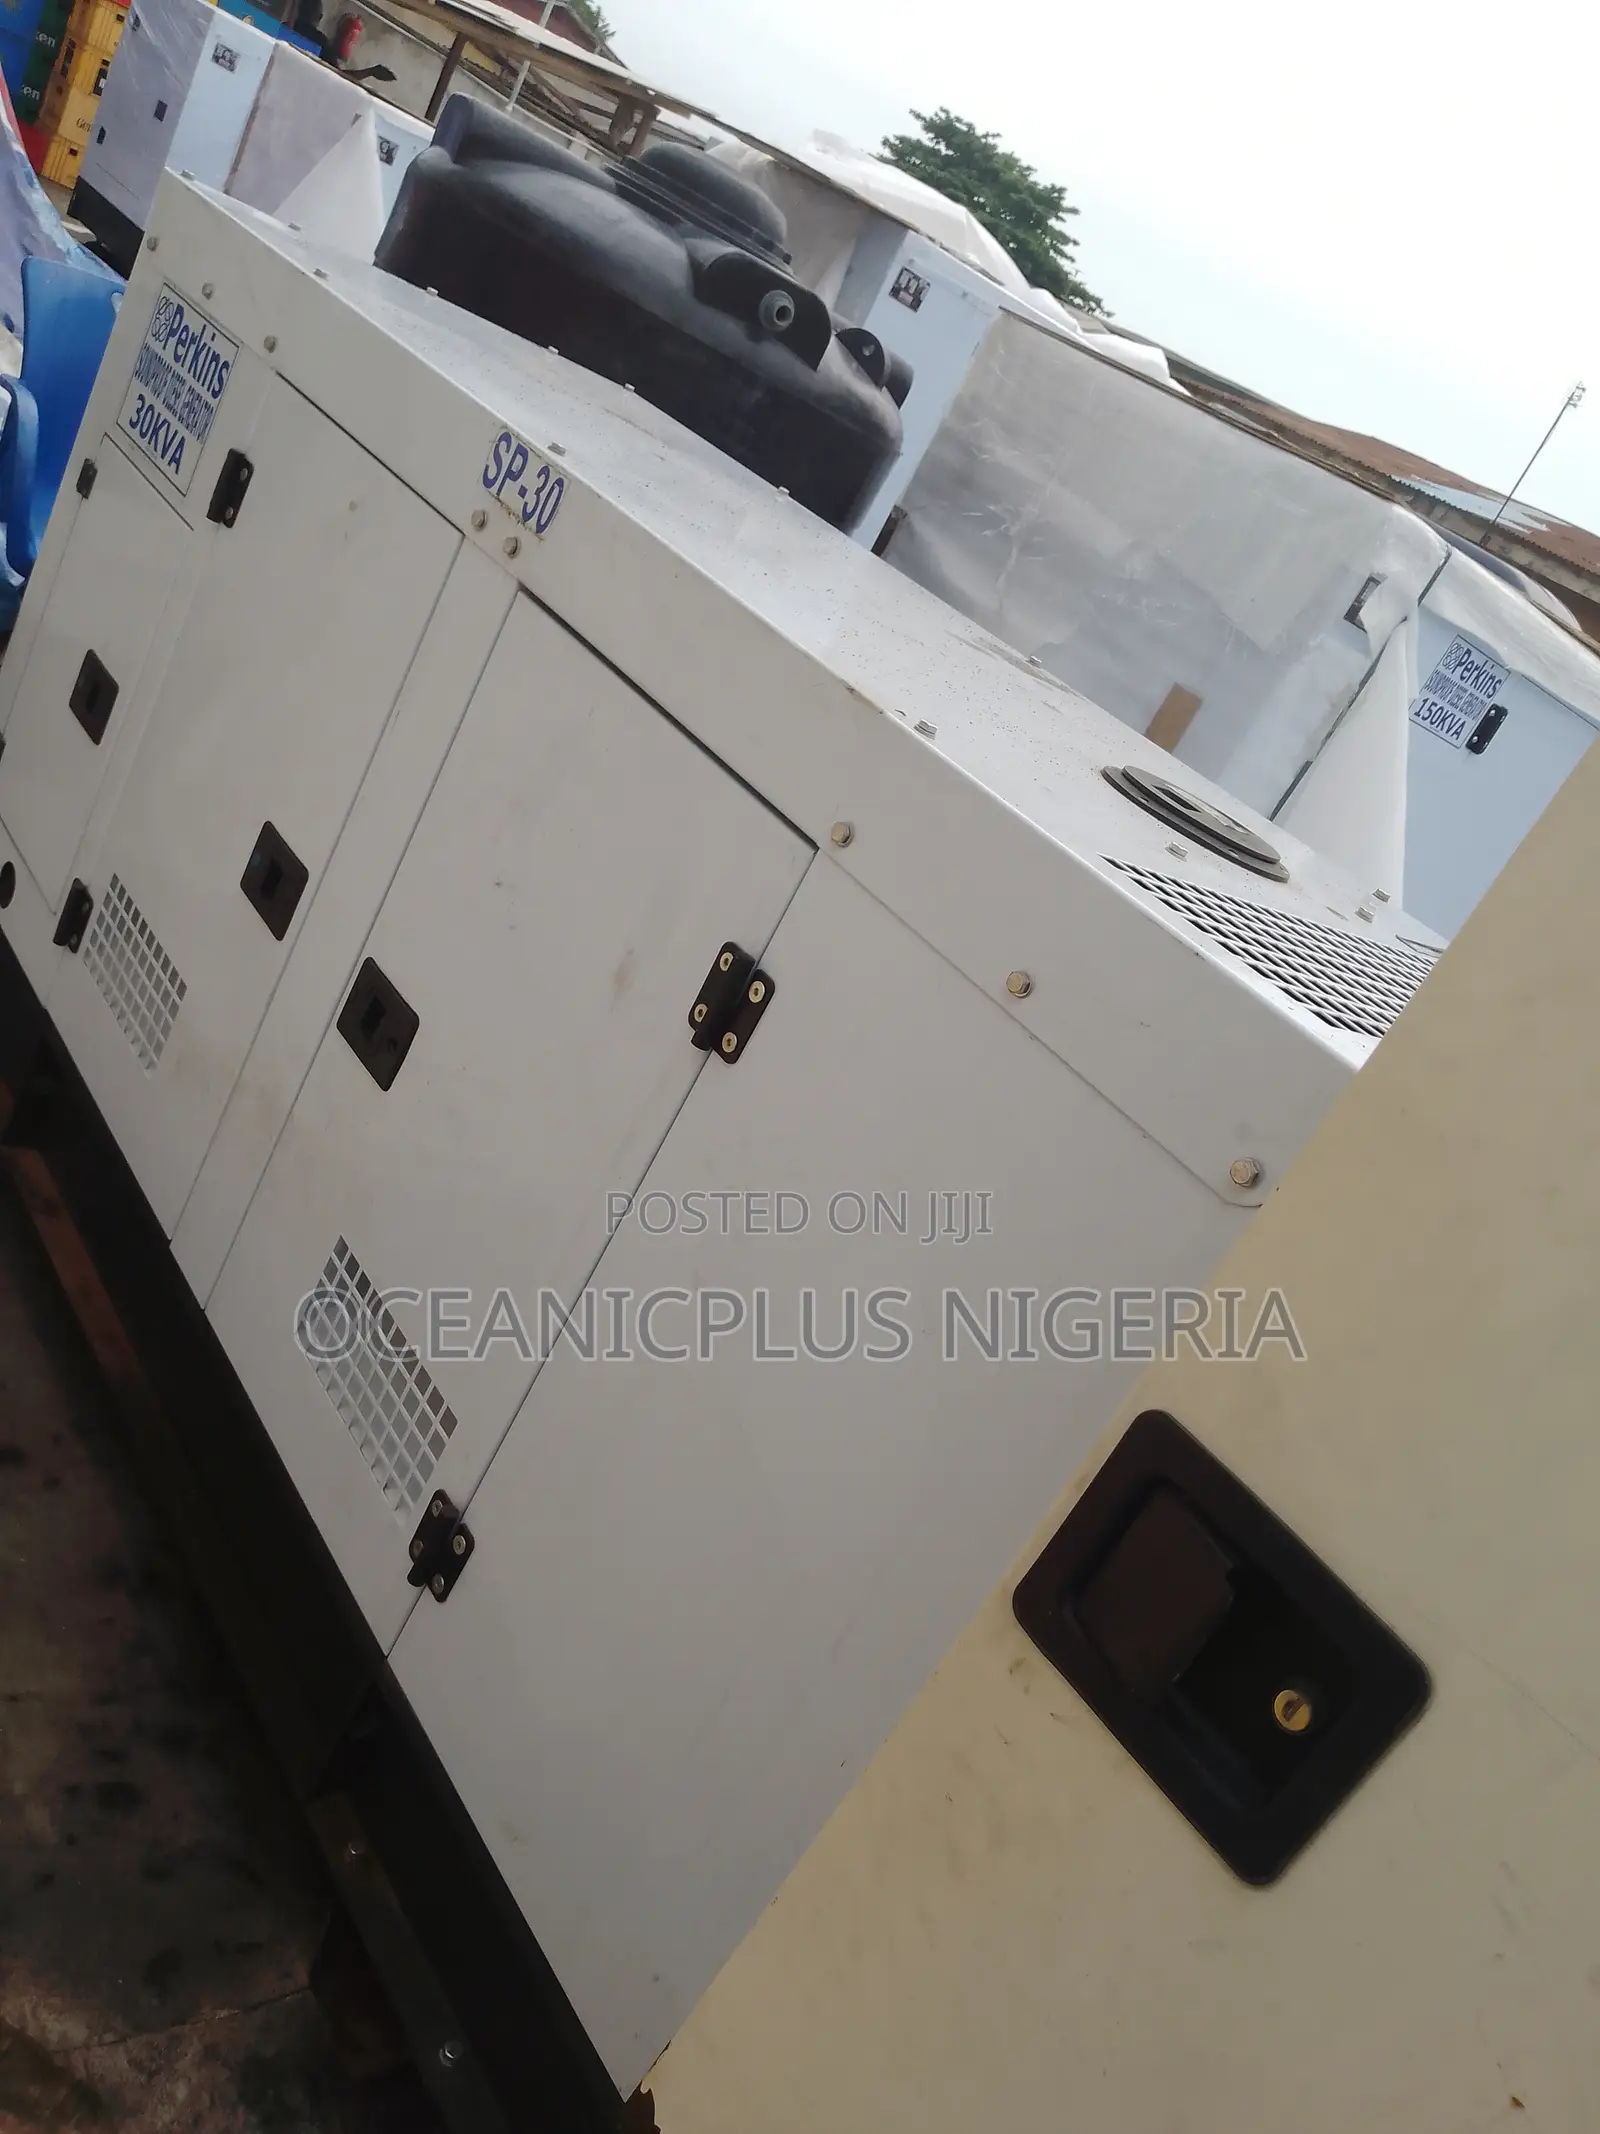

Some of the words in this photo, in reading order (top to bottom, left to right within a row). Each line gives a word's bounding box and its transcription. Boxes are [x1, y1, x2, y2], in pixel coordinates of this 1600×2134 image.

[162, 303, 230, 400] Perkins
[129, 393, 186, 475] 30KVA
[482, 431, 565, 534] SP-30
[1451, 647, 1503, 700] Perkins
[1413, 697, 1467, 741] 150KVA
